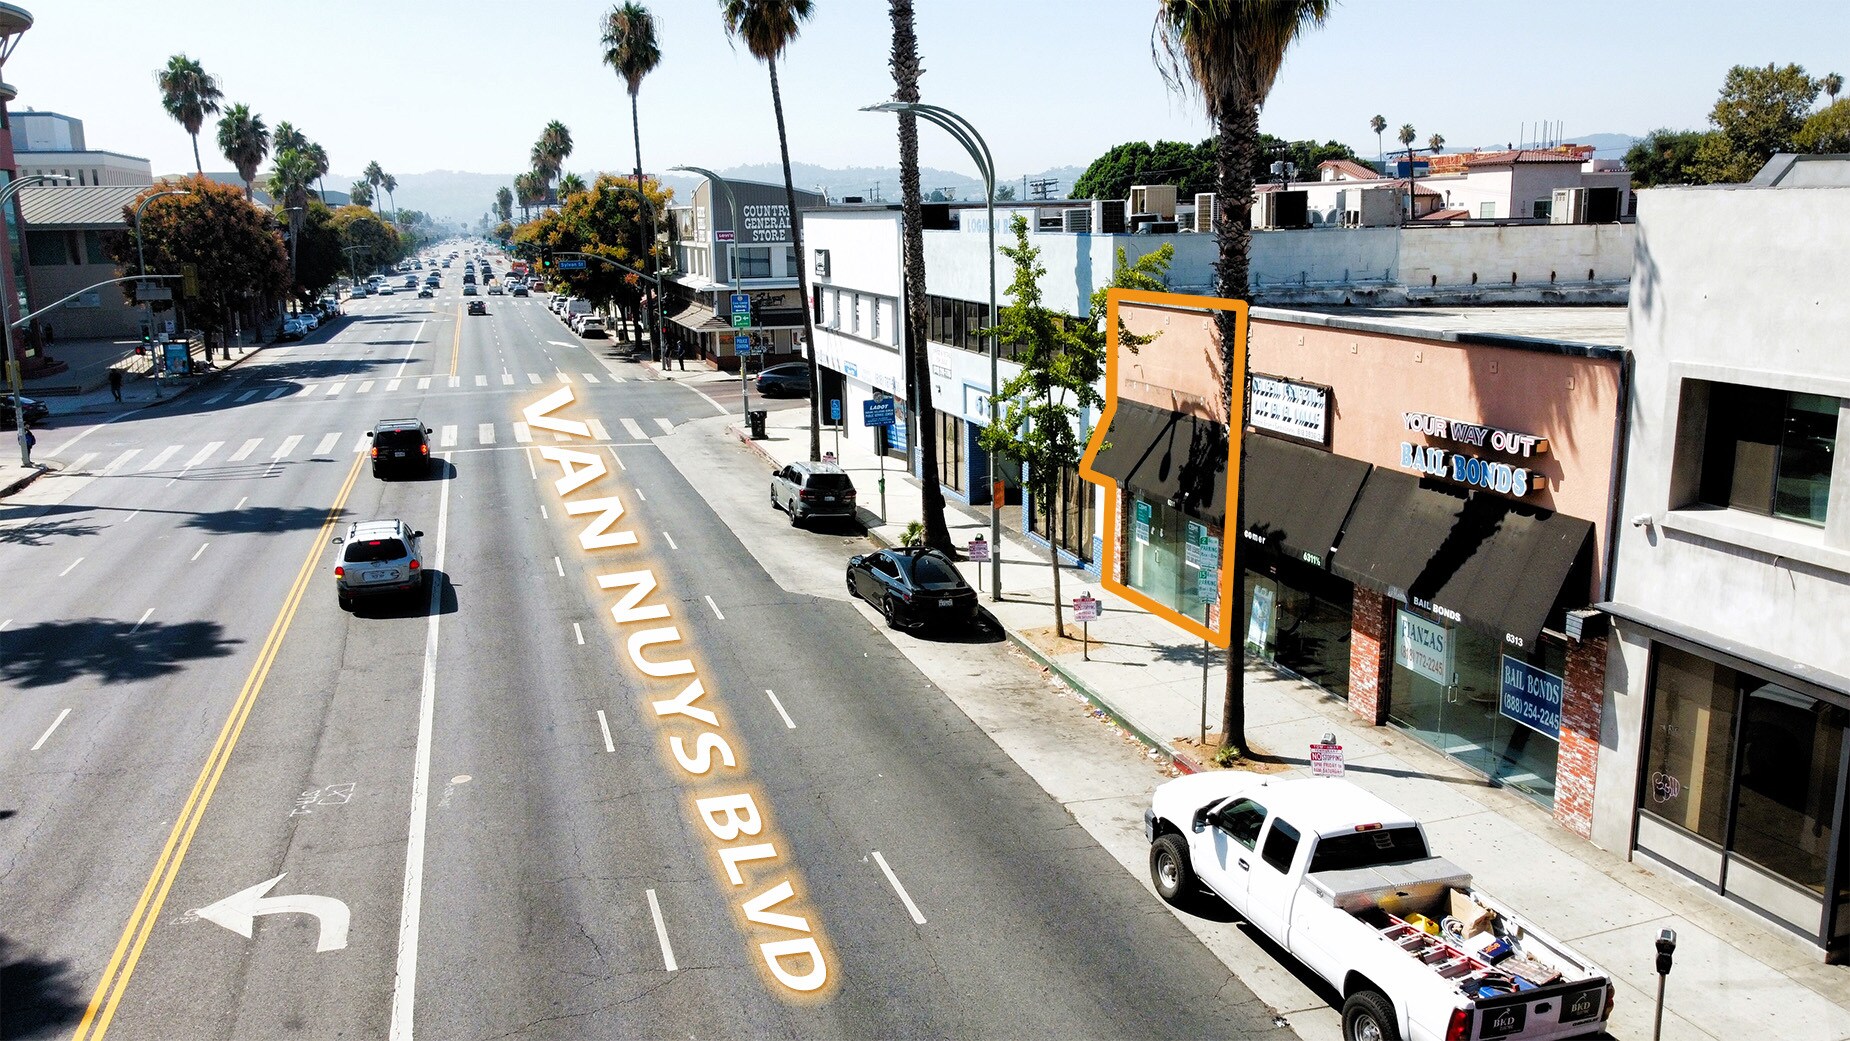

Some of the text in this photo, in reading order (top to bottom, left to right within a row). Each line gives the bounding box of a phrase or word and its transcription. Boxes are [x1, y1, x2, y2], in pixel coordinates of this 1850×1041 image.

[743, 205, 790, 217] COUNTRY
[744, 217, 791, 229] GENERAL
[967, 218, 1000, 233] LOGMN
[752, 229, 786, 241] STORE
[734, 315, 742, 326] P
[1401, 412, 1536, 458] YOUR WAY OUT
[1400, 441, 1527, 497] BAIL BONDS
[1413, 596, 1462, 622] BAIL BONDS
[1402, 620, 1444, 653] FIANZAS
[1505, 632, 1524, 647] 6313
[1504, 665, 1560, 705] BAIL BONDS
[1503, 692, 1560, 730] (888) 254-2245
[1311, 752, 1322, 761] NO
[1571, 1002, 1591, 1012] BKD
[1493, 1017, 1515, 1028] BKD
